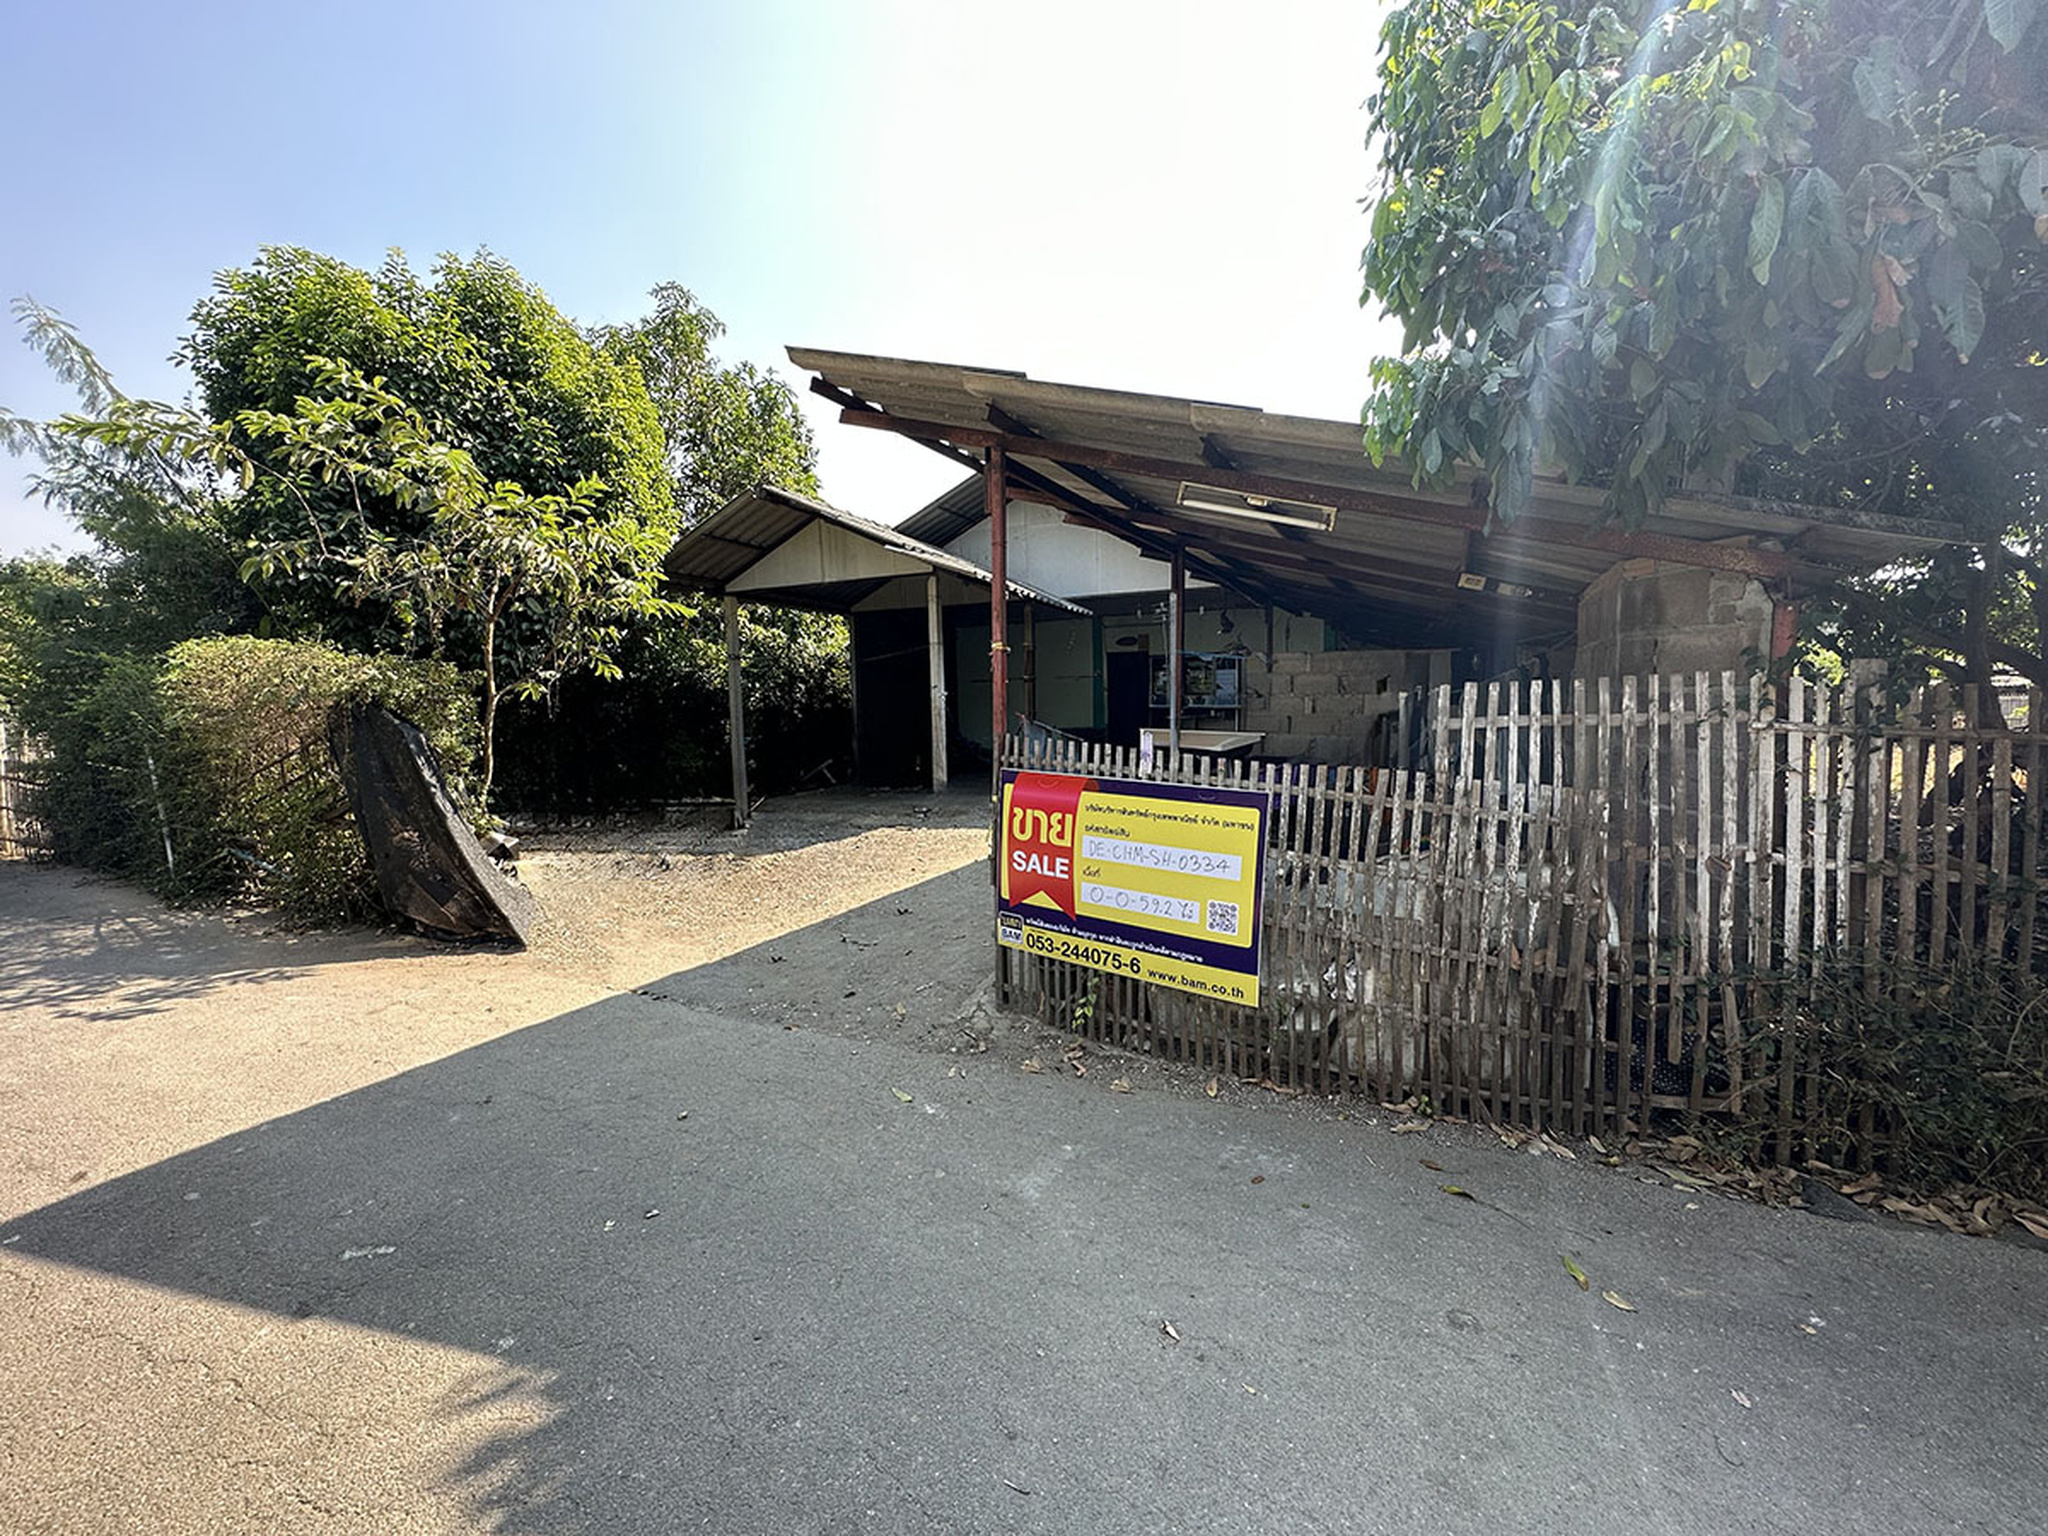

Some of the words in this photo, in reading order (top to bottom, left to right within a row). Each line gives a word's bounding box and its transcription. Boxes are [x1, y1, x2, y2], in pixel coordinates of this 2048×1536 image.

[1012, 806, 1073, 847] ขาย
[1012, 850, 1070, 880] SALE
[1026, 933, 1141, 975] 053-244075-6
[1147, 970, 1244, 999] www.bam.co.th
